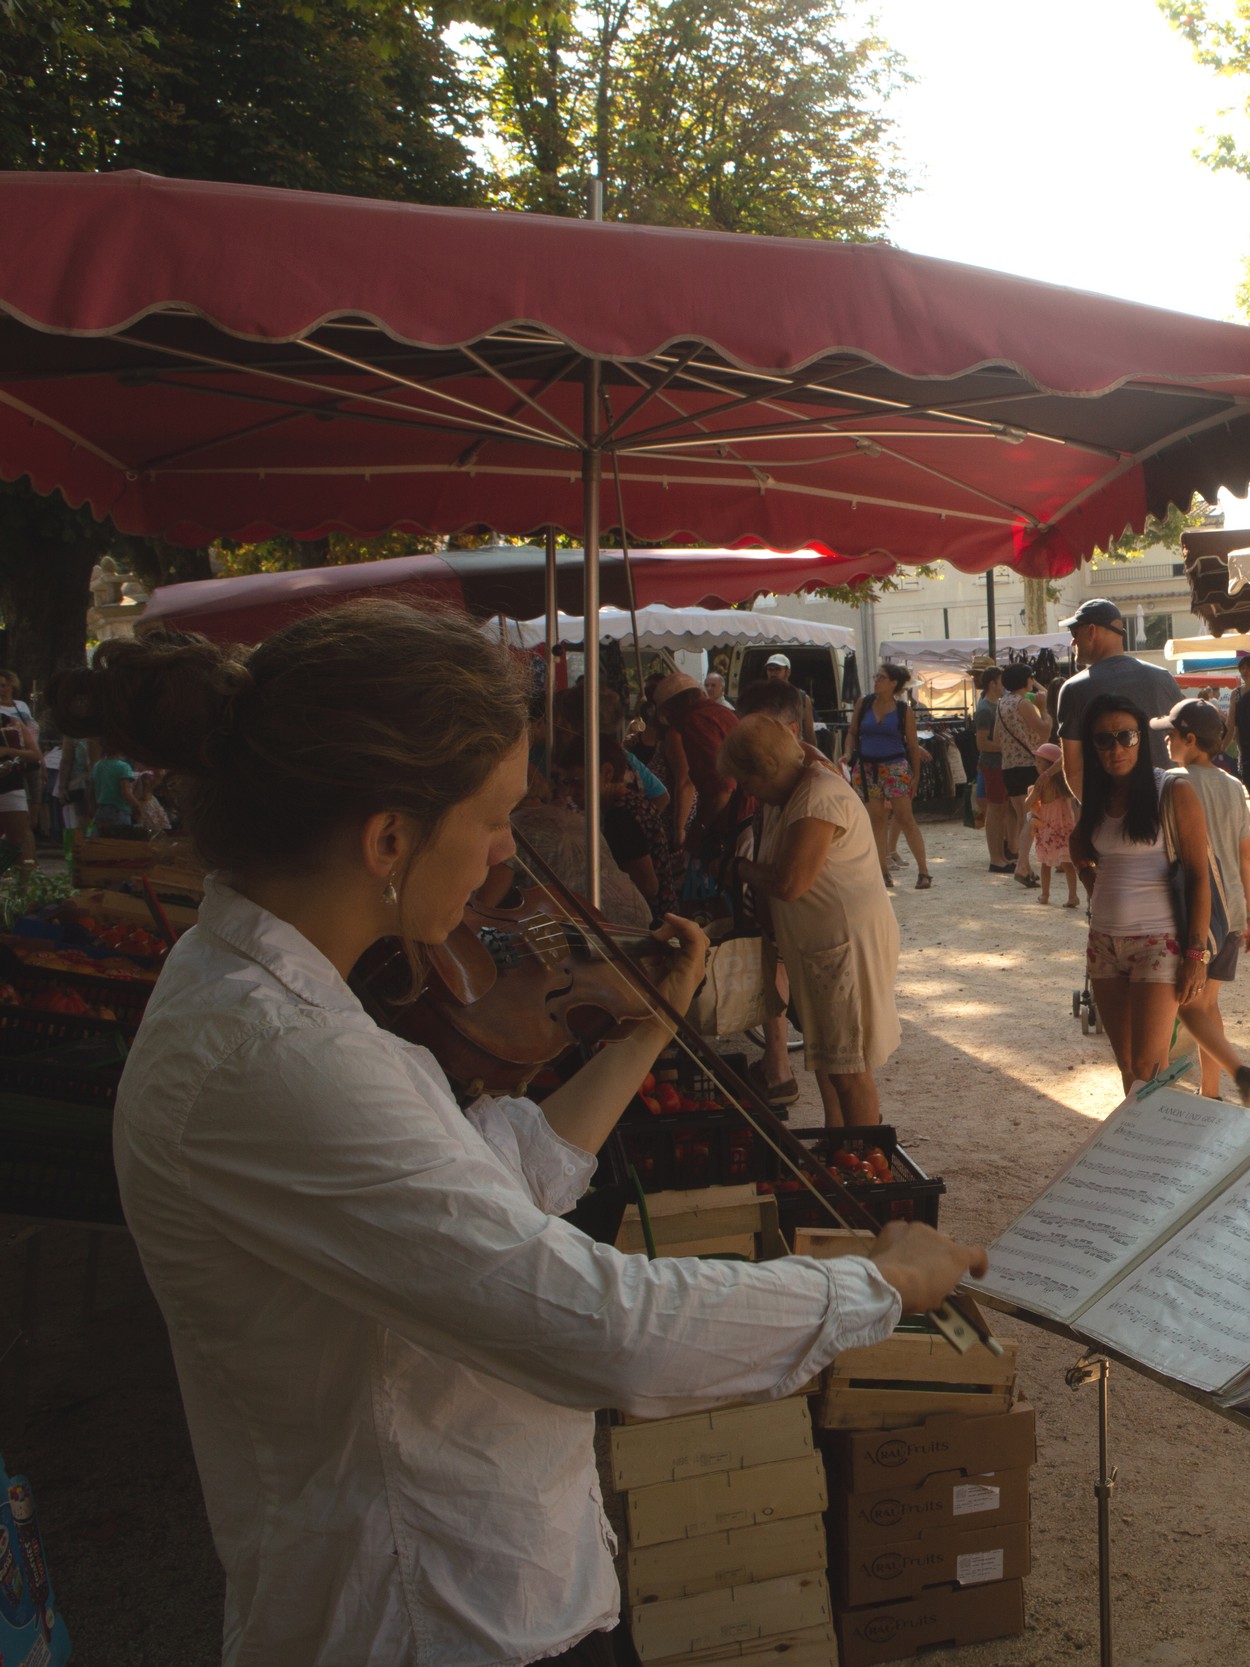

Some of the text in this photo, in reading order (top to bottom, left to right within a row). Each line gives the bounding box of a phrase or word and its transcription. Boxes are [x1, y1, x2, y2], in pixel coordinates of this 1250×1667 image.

[907, 1441, 949, 1456] Fruits
[901, 1501, 943, 1515] Fruits
[902, 1553, 944, 1568] Fruits
[895, 1614, 937, 1630] Fruits
